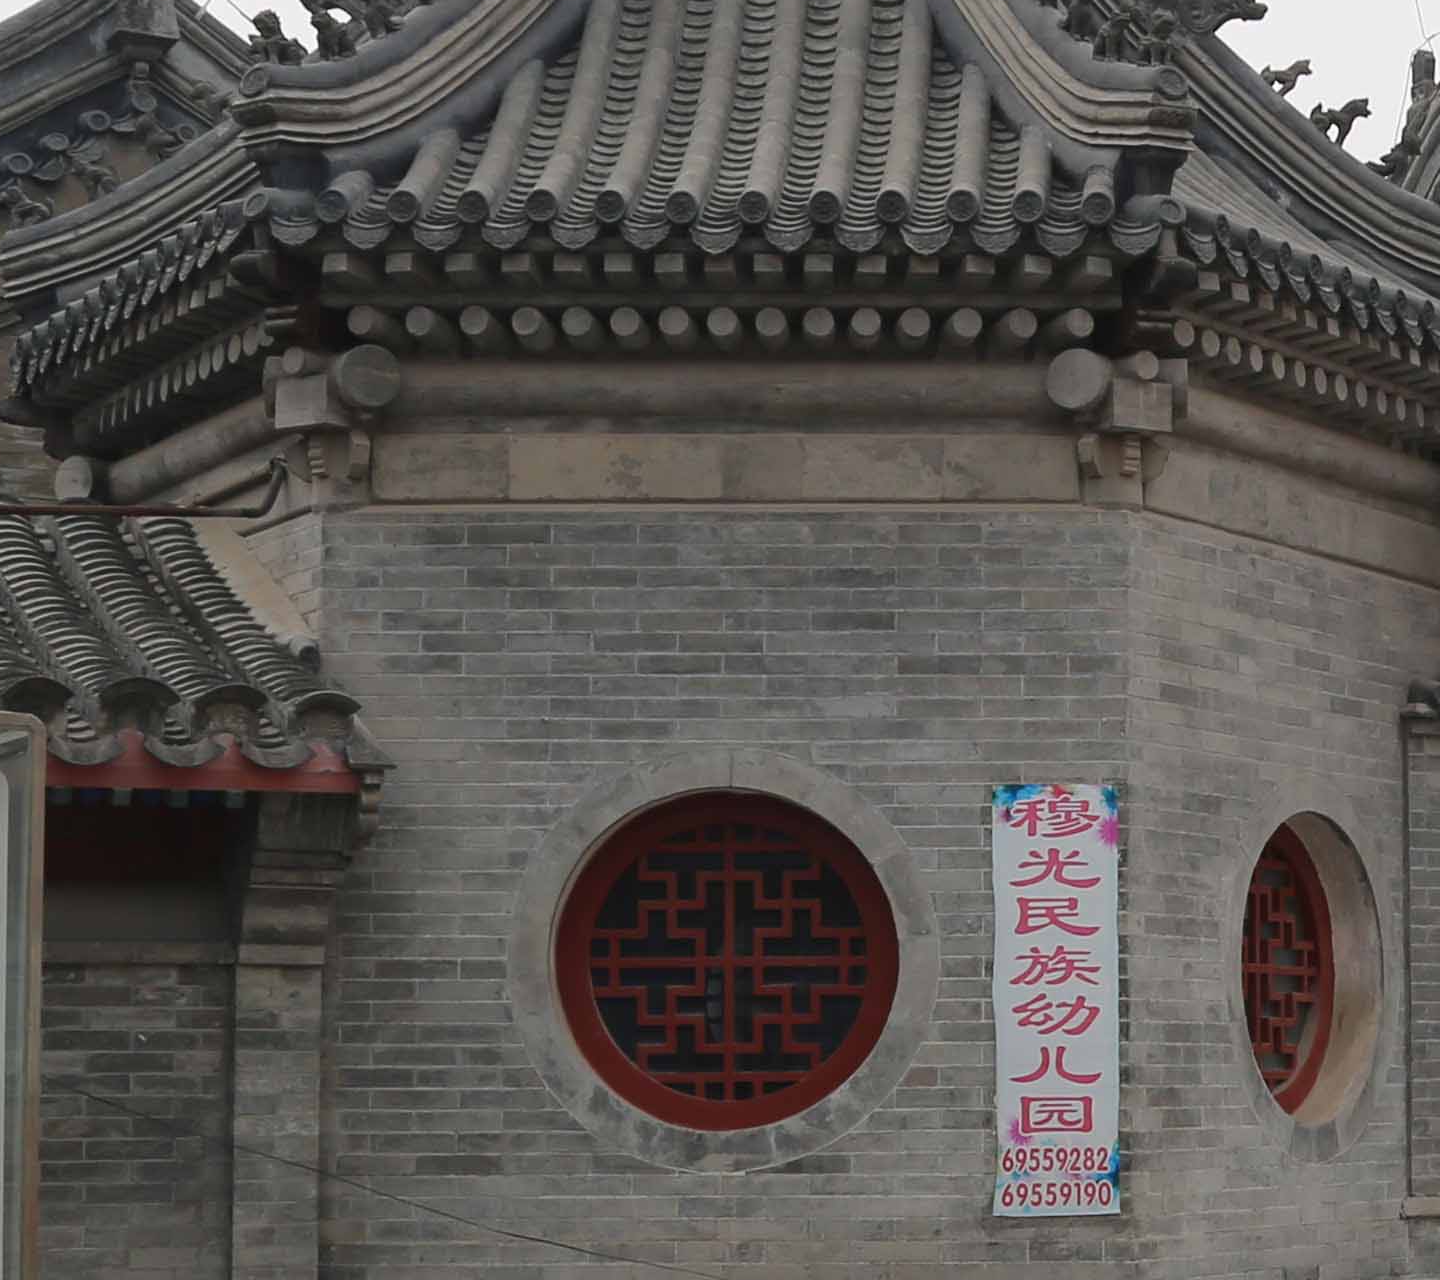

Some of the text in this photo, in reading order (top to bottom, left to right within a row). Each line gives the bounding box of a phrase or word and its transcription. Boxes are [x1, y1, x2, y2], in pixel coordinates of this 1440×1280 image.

[1008, 796, 1103, 1135] 穆光民族幼儿园
[1001, 1146, 1109, 1175] 69559282
[1000, 1181, 1112, 1208] 69559190
